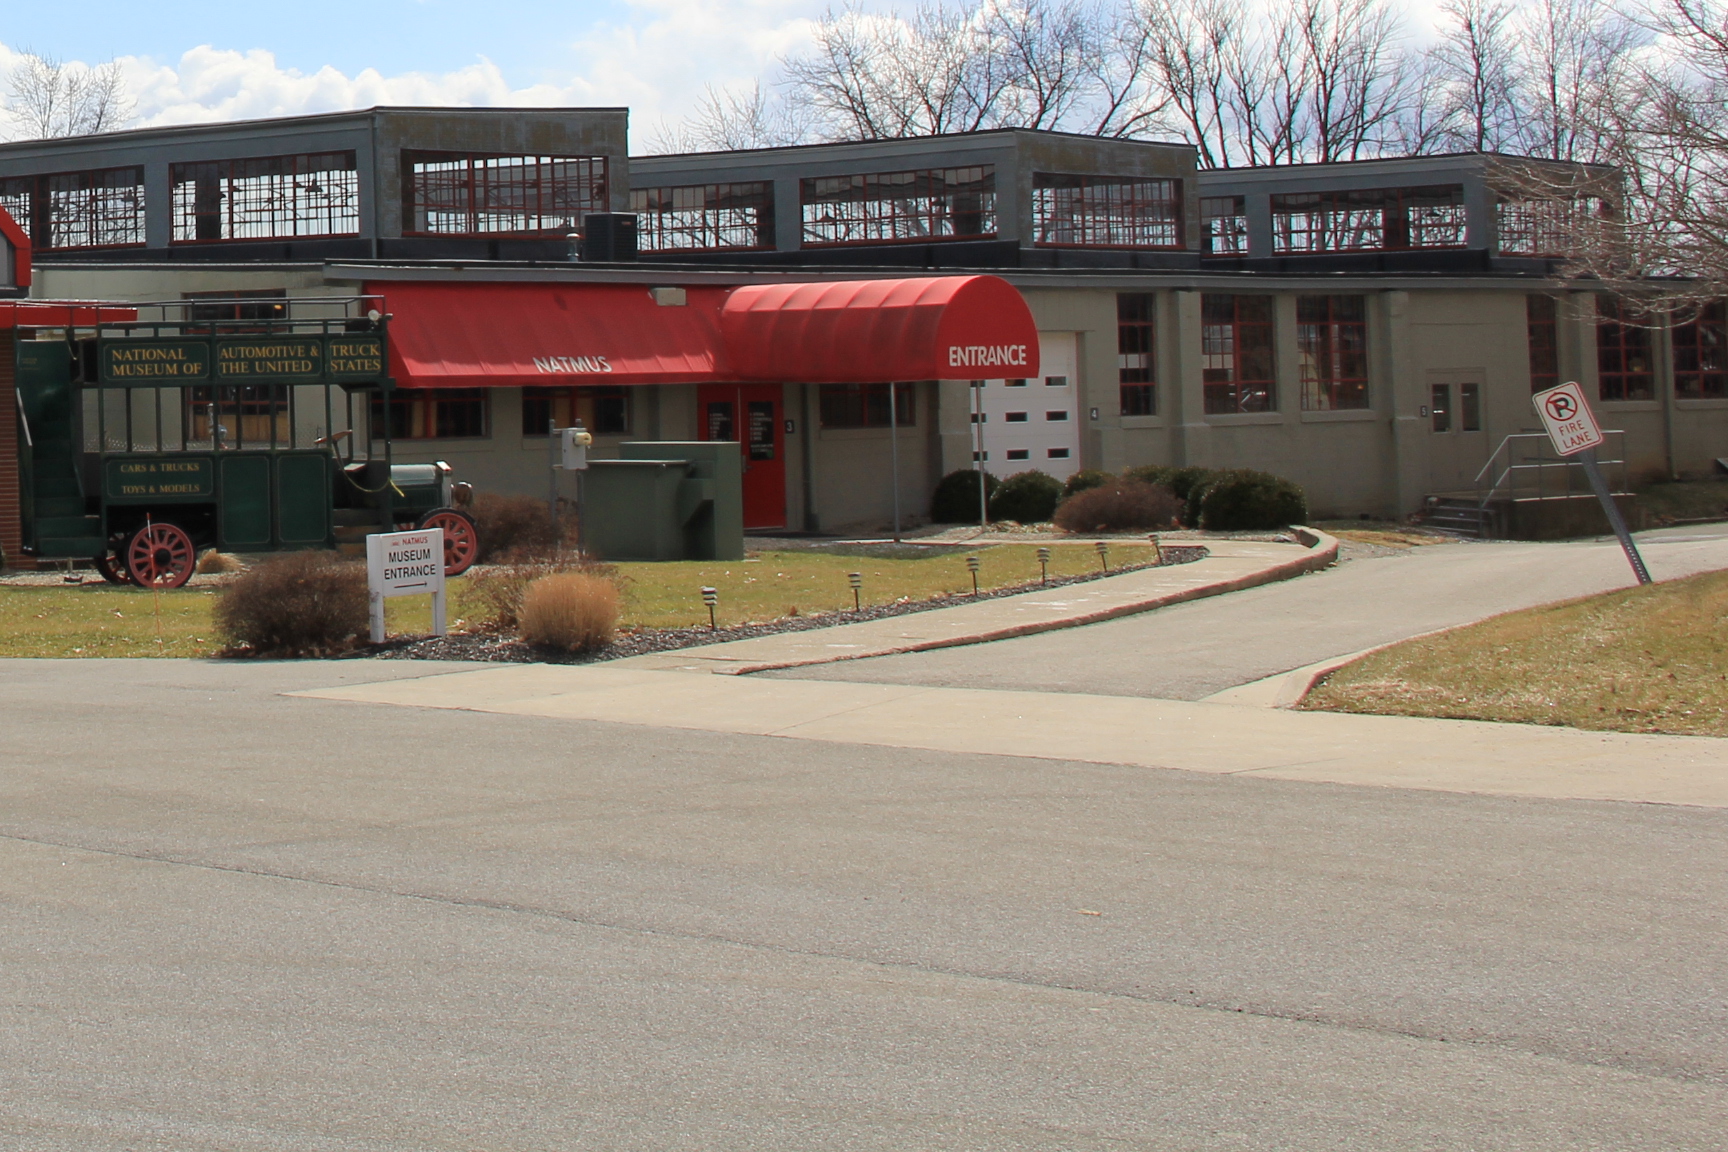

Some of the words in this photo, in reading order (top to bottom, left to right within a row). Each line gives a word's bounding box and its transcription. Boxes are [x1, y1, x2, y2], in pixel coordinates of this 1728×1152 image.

[112, 348, 187, 361] NATIONAL
[219, 345, 306, 359] AUTOMOTIVE
[310, 346, 320, 357] &
[329, 344, 381, 357] TRUCK
[949, 344, 1027, 367] ENTRANCE
[112, 363, 179, 376] MUSEUM
[183, 362, 202, 375] OF
[219, 361, 250, 374] THE
[255, 360, 312, 373] UNITED
[330, 359, 381, 372] STATES
[532, 356, 612, 374] NATMUS
[786, 421, 793, 432] 3
[1558, 419, 1585, 436] FIRE
[1563, 431, 1592, 449] LANE
[120, 464, 147, 473] CARS
[150, 464, 157, 472] &
[160, 463, 200, 472] TRUCKS
[121, 485, 146, 494] TOYS
[149, 485, 156, 493] &
[159, 484, 200, 493] MODELS
[402, 536, 428, 546] NATMUS
[388, 548, 431, 563] MUSEUM
[384, 564, 436, 580] ENTRANCE
